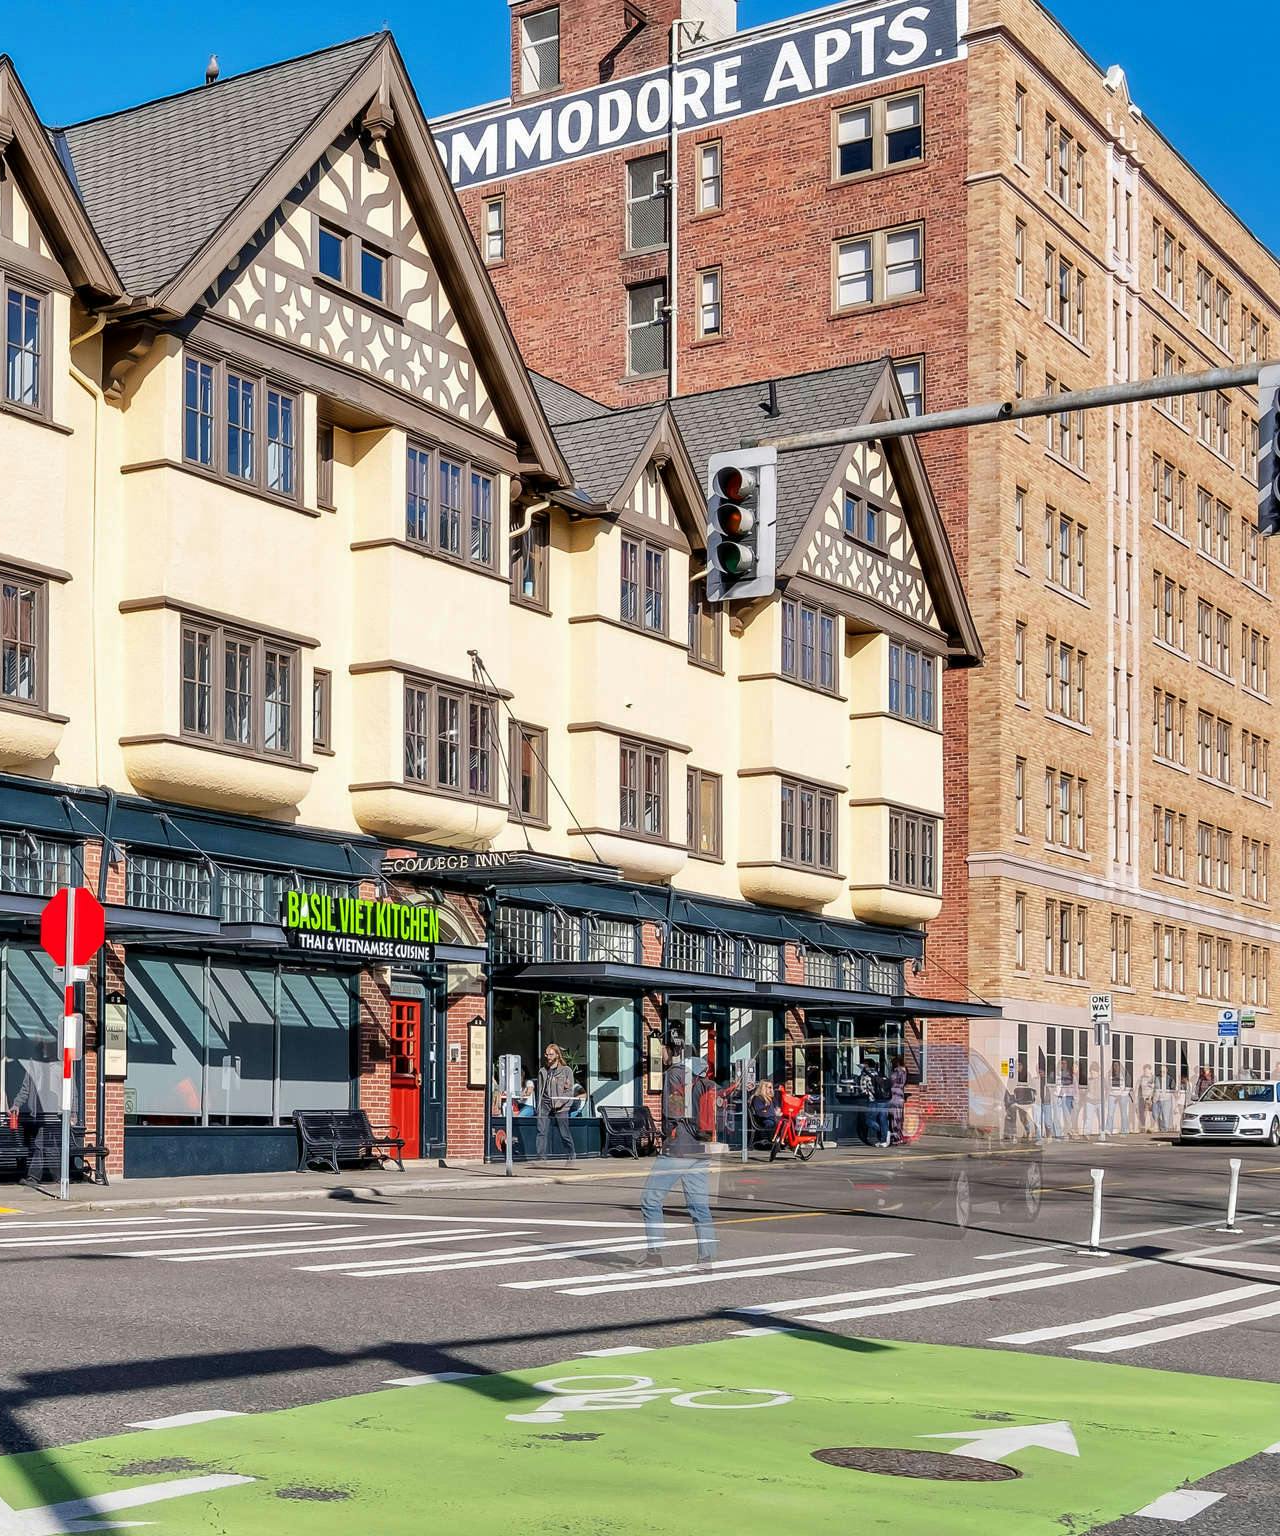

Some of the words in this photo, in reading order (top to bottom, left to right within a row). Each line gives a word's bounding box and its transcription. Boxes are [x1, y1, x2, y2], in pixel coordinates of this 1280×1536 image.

[434, 54, 743, 185] MMODORE
[763, 6, 943, 102] APTS.
[393, 855, 469, 873] COLLEGE
[475, 853, 509, 867] INN
[287, 890, 336, 932] BASIL
[339, 897, 373, 936] VIET
[376, 901, 440, 944] KITCHEN
[298, 933, 326, 950] THAI
[327, 938, 334, 951] &
[335, 936, 394, 957] VIETNAMESE
[394, 945, 430, 961] CUISINE
[1091, 995, 1110, 1003] ONE
